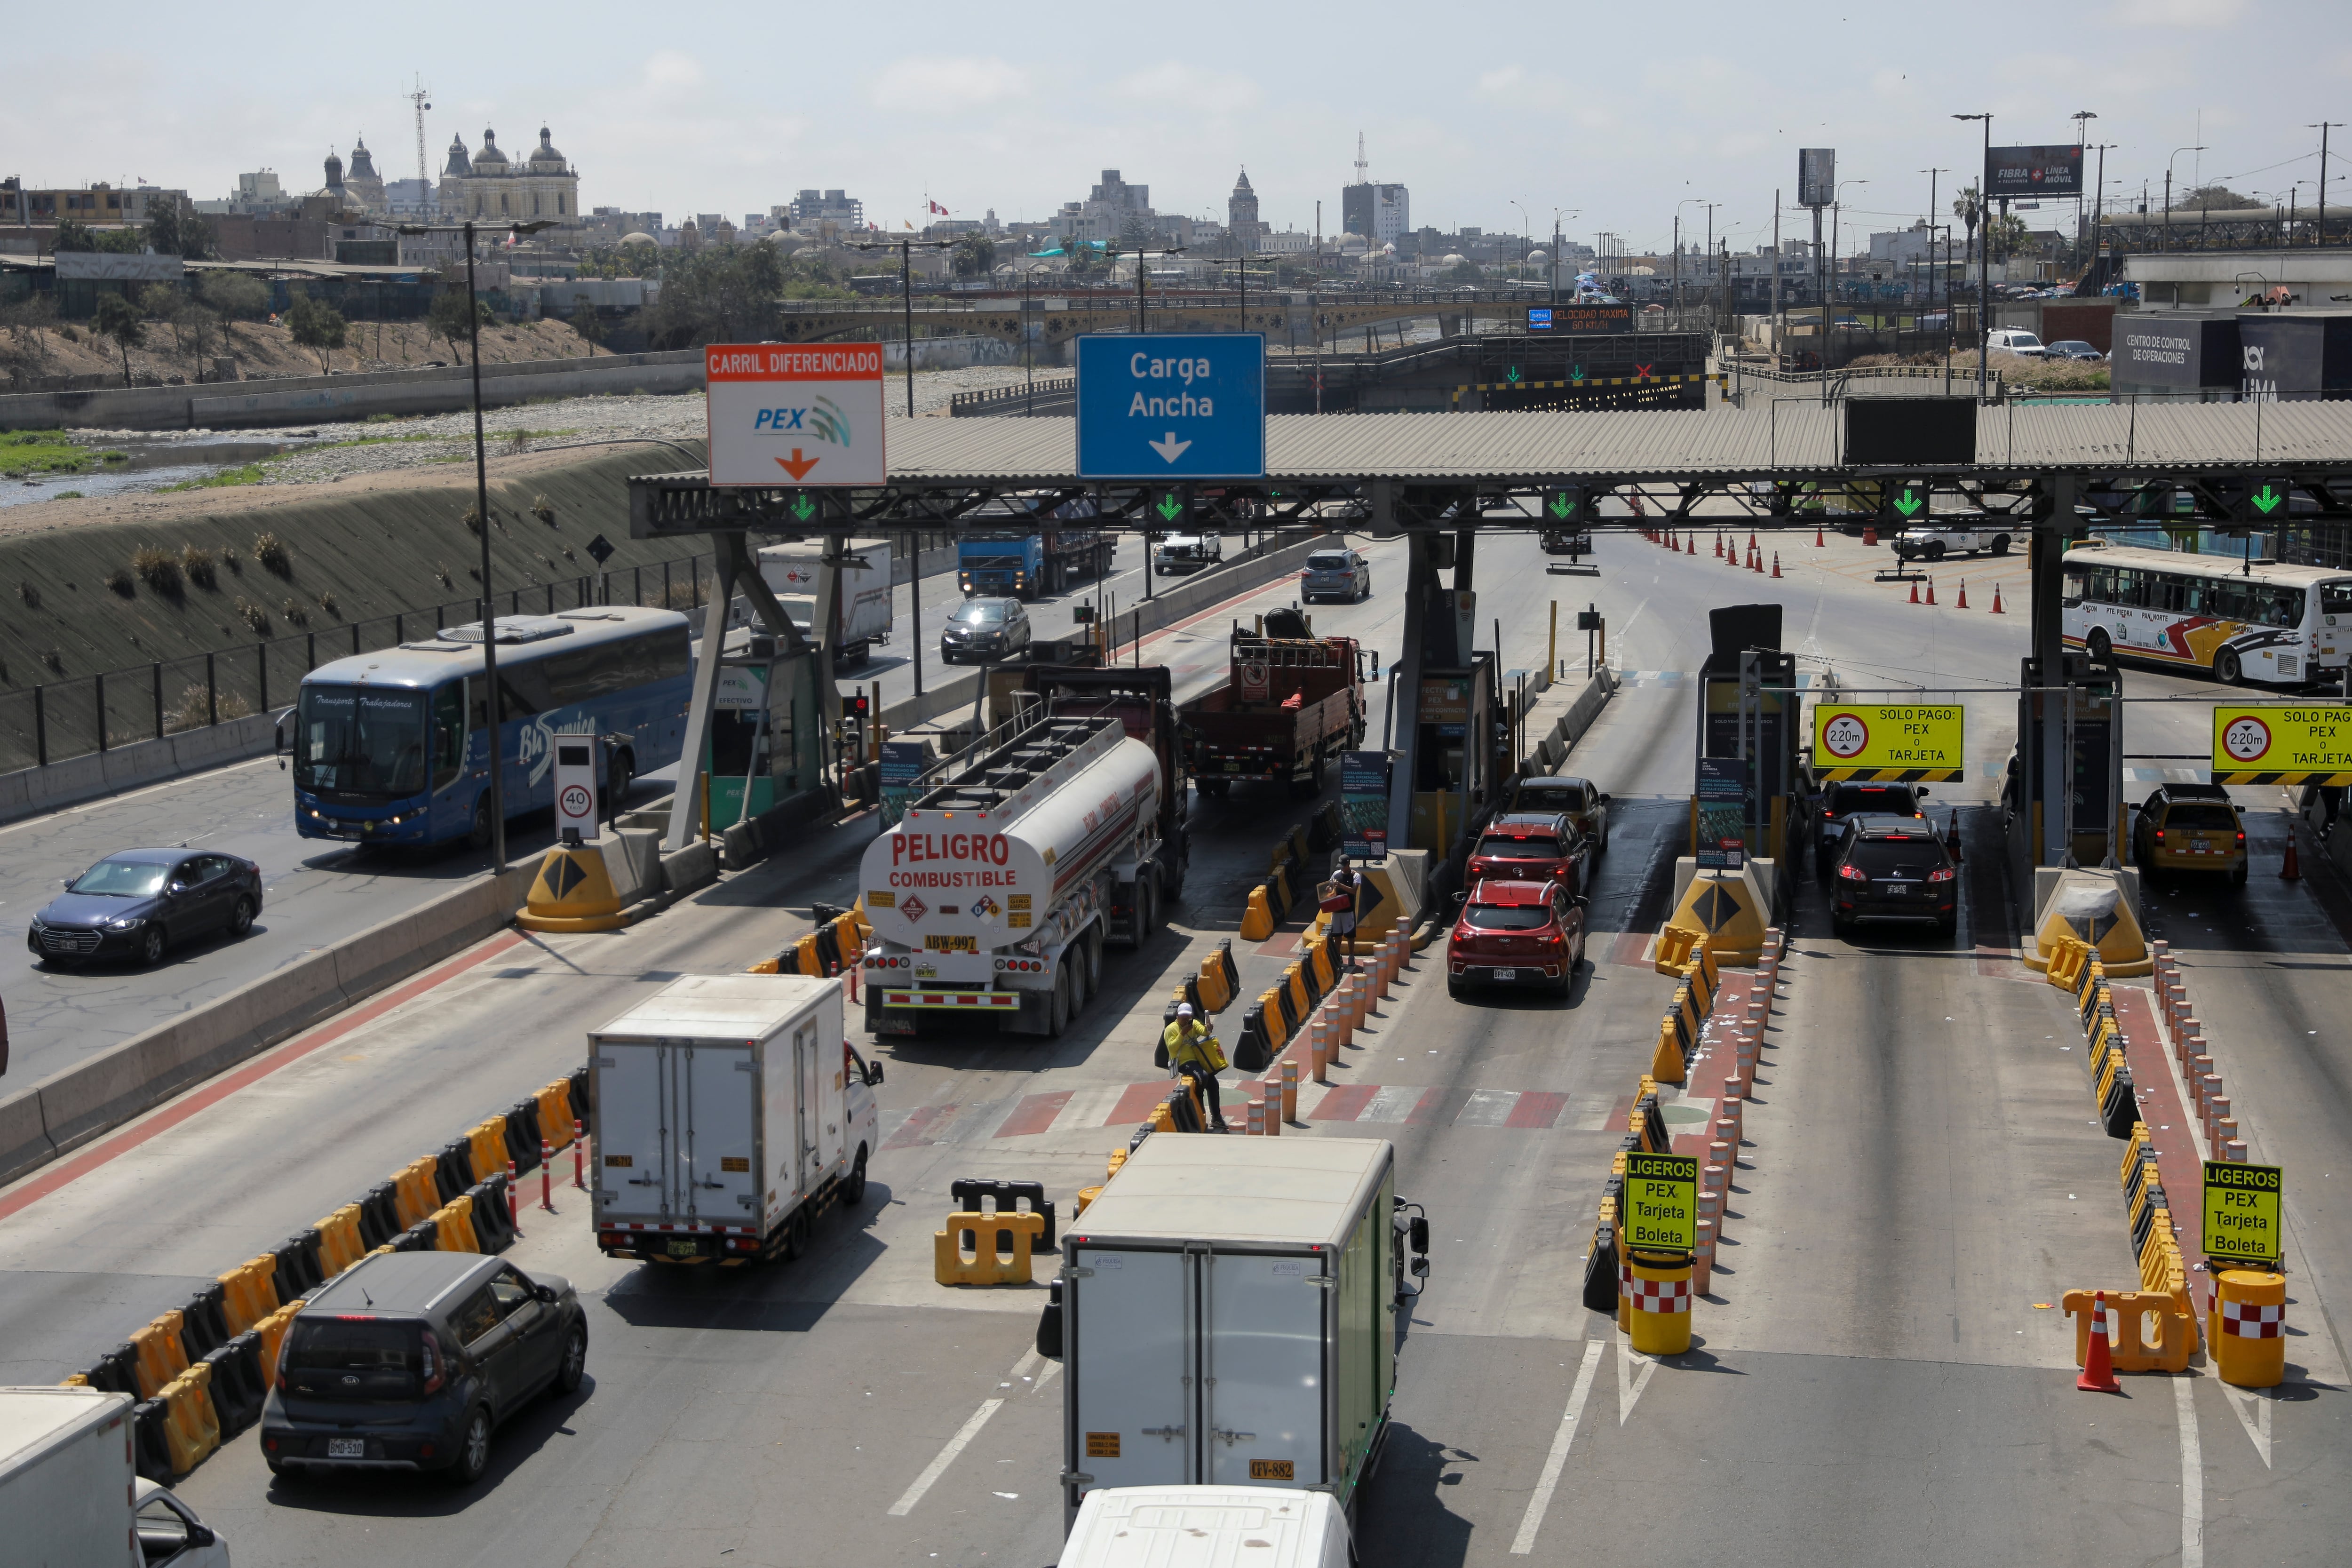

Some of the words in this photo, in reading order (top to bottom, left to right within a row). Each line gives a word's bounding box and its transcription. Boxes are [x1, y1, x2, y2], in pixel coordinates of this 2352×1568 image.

[1998, 168, 2027, 178] FIBRA
[2045, 165, 2068, 174] LÍNEA
[2045, 174, 2072, 183] MÓVIL
[1552, 310, 1596, 319] VELOCIDAD
[1600, 309, 1628, 318] MAXIMA
[1572, 321, 1583, 329] 60
[1586, 320, 1608, 329] KM/H
[2127, 334, 2150, 346] CENTRO
[2152, 336, 2160, 348] DE
[2161, 337, 2190, 350] CONTROL
[710, 353, 765, 374] CARRIL
[770, 351, 878, 373] DIFERENCIADO
[2133, 349, 2141, 360] DE
[2142, 350, 2185, 364] OPERACIONES
[1130, 352, 1210, 385] Carga
[1128, 392, 1214, 417] Ancha
[754, 408, 807, 430] PEX
[2230, 624, 2253, 633] GAMARRA
[316, 695, 355, 706] Transporte
[359, 697, 412, 708] Trabajadores
[1880, 709, 1913, 720] SOLO
[1918, 709, 1955, 720] PAGO:
[2284, 712, 2320, 722] SOLO
[1904, 724, 1929, 734] PEX
[2310, 726, 2336, 737] PEX
[1830, 730, 1860, 742] 2.20m
[2231, 733, 2262, 745] 2.20m
[1888, 749, 1945, 760] TARJETA
[2292, 753, 2352, 764] TARJETA
[566, 793, 585, 804] 40
[892, 833, 1009, 866] PELIGRO
[890, 870, 1016, 887] COMBUSTIBLE
[975, 906, 981, 914] 0
[991, 905, 998, 914] 0
[868, 937, 885, 951] PELIGRO
[925, 936, 975, 949] ABW-997
[1021, 939, 1039, 954] PELIGRO
[870, 1019, 911, 1030] SCANIA
[606, 1156, 632, 1166] BWE-712
[1628, 1160, 1695, 1178] LIGEROS
[2206, 1167, 2279, 1187] LIGEROS
[1646, 1182, 1677, 1198] PEX
[2225, 1193, 2258, 1208] PEX
[1636, 1201, 1685, 1220] Tarjeta
[2214, 1210, 2267, 1230] Tarjeta
[1636, 1226, 1683, 1244] Boleta
[669, 1245, 695, 1254] BWE-712
[2215, 1235, 2266, 1254] Boleta
[331, 1443, 362, 1454] BMD-510
[1252, 1462, 1292, 1477] CFV-882
